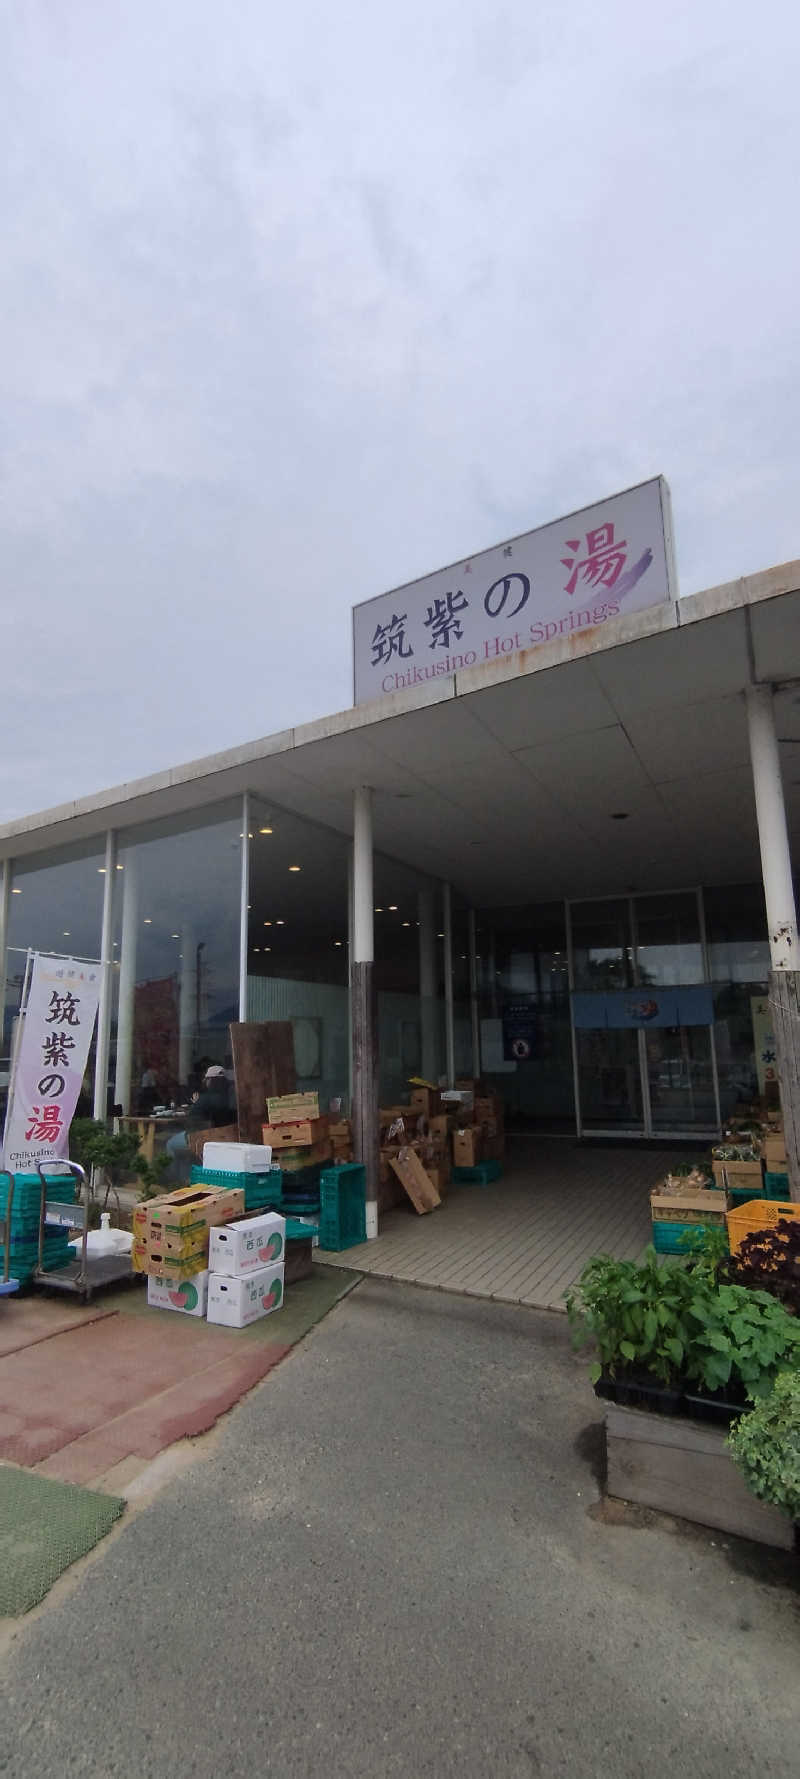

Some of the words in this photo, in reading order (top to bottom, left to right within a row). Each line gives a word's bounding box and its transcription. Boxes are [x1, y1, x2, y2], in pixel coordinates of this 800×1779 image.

[370, 522, 628, 667] 筑紫の湯
[381, 650, 477, 693] Chikusino
[484, 631, 522, 659] Hot
[529, 600, 621, 644] Springs
[24, 990, 81, 1143] 筑紫の湯
[15, 1160, 32, 1169] Hot
